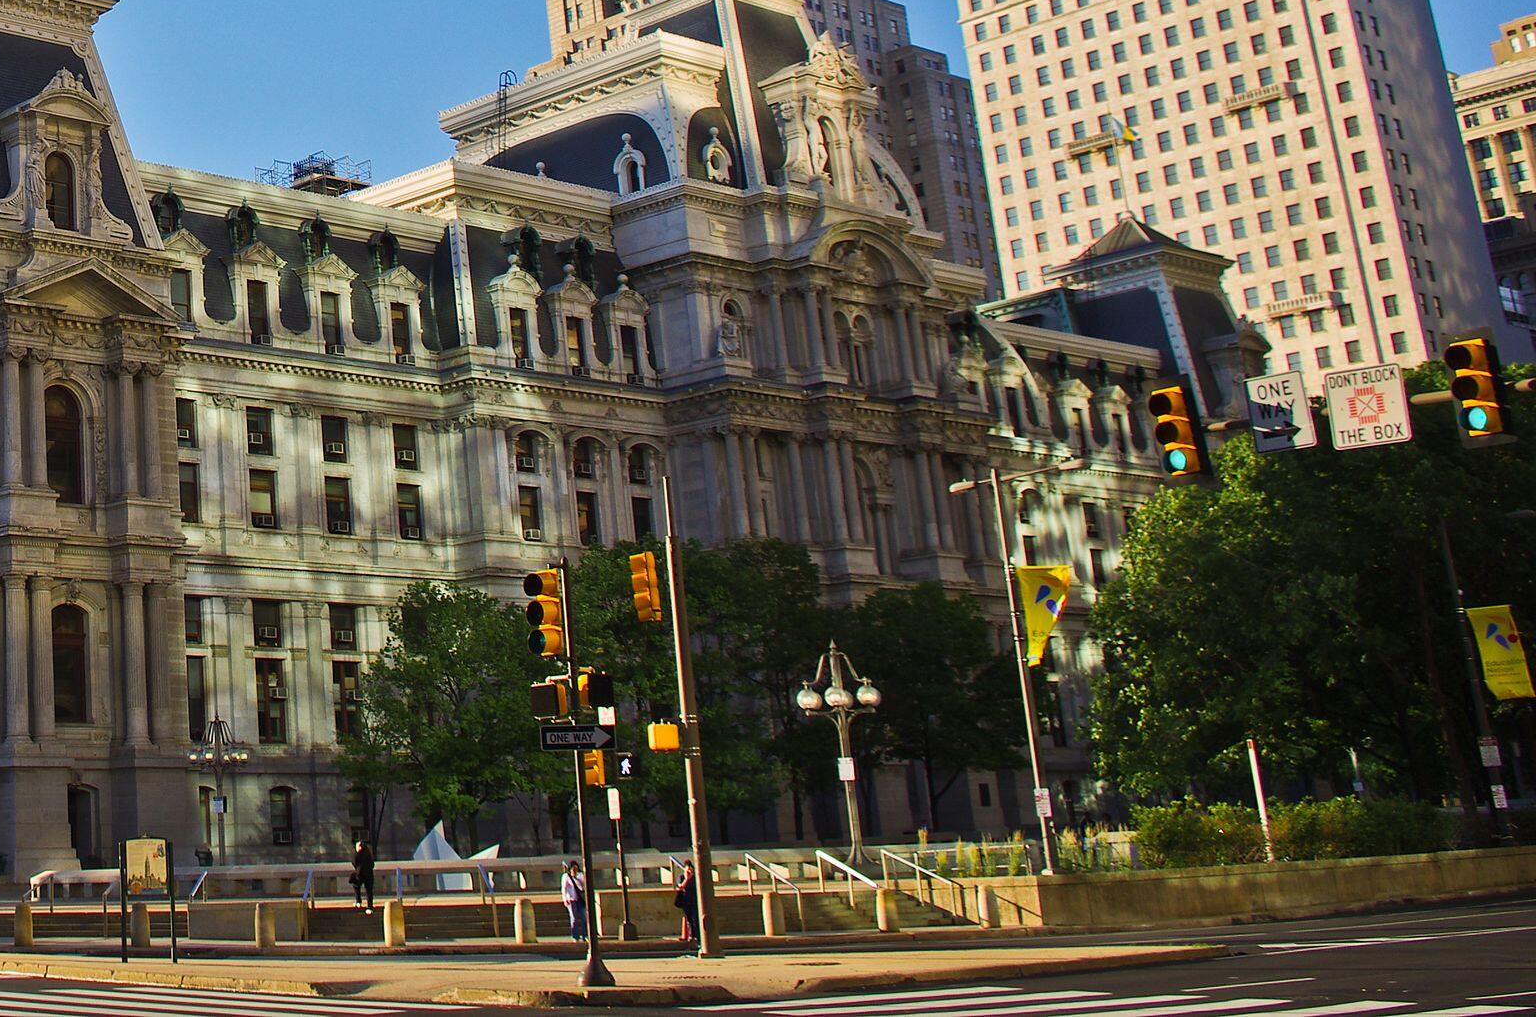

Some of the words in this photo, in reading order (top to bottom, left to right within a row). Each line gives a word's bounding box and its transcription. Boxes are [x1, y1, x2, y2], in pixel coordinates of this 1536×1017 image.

[1361, 367, 1397, 384] BLOCK
[1257, 380, 1292, 399] ONE
[1259, 399, 1295, 419] WAY
[1340, 428, 1366, 444] THE
[1374, 423, 1404, 440] BOX
[550, 733, 570, 742] ONE
[573, 732, 593, 742] WAY
